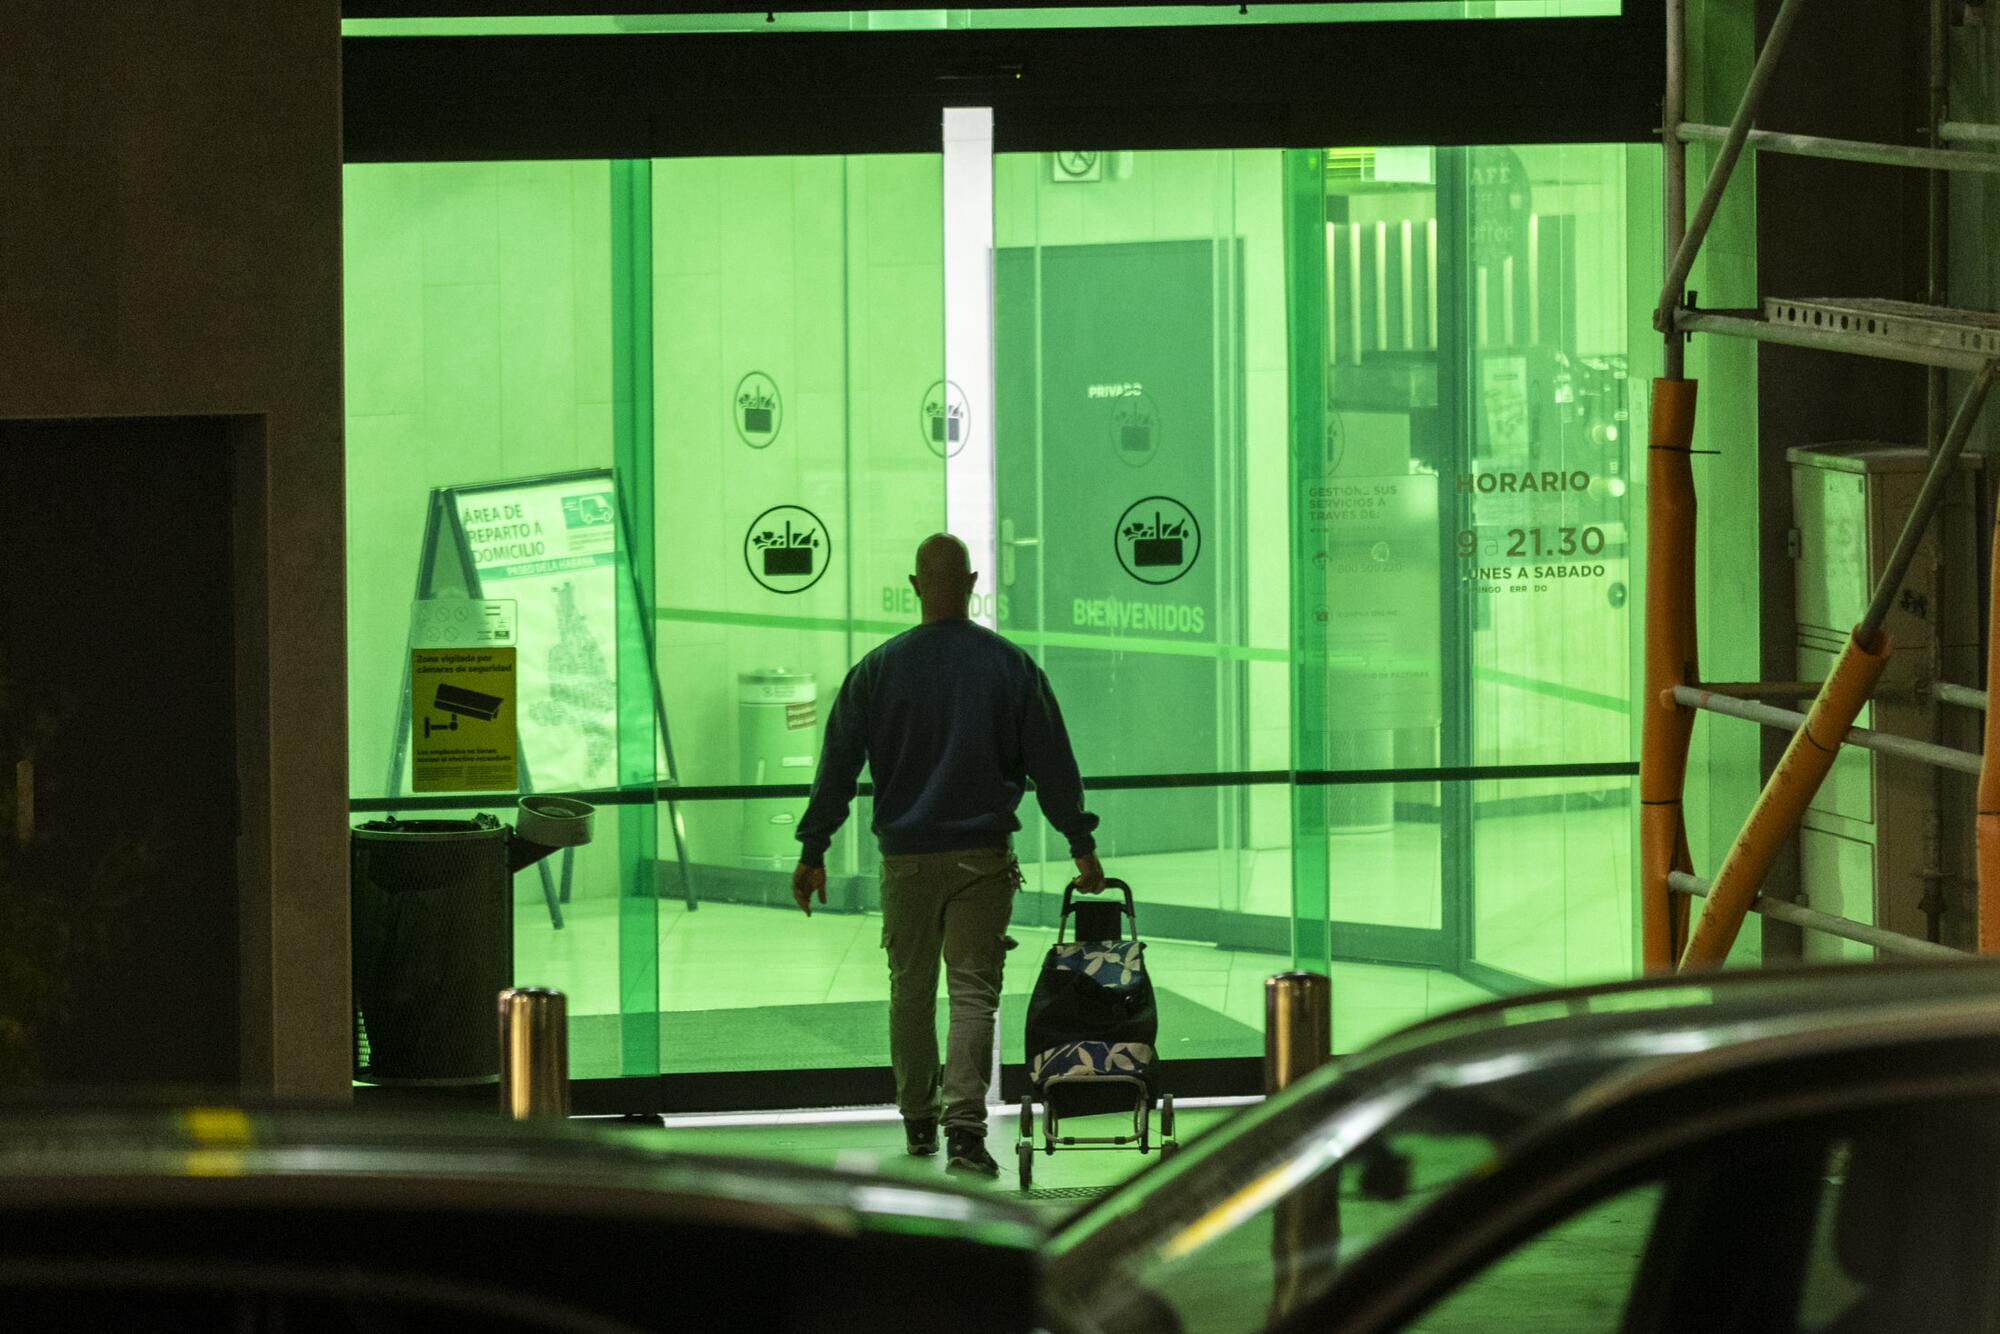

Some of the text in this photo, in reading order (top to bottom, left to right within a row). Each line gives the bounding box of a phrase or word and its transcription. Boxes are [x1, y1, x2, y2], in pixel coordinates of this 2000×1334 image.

[1088, 382, 1142, 398] PRIVADO
[1374, 486, 1397, 496] SUS
[1456, 471, 1590, 494] HORARIO
[463, 504, 523, 524] ÁREA DE
[1309, 498, 1374, 509] SERVICIOS
[468, 522, 544, 544] REPARTO A
[1458, 530, 1478, 558] 9
[1506, 526, 1605, 557] 21.30
[474, 542, 545, 564] DOMICILIO
[1467, 565, 1605, 580] UNES A SABADO
[882, 586, 1009, 621] BIEDOS
[1073, 598, 1204, 633] BIENVENIDOS
